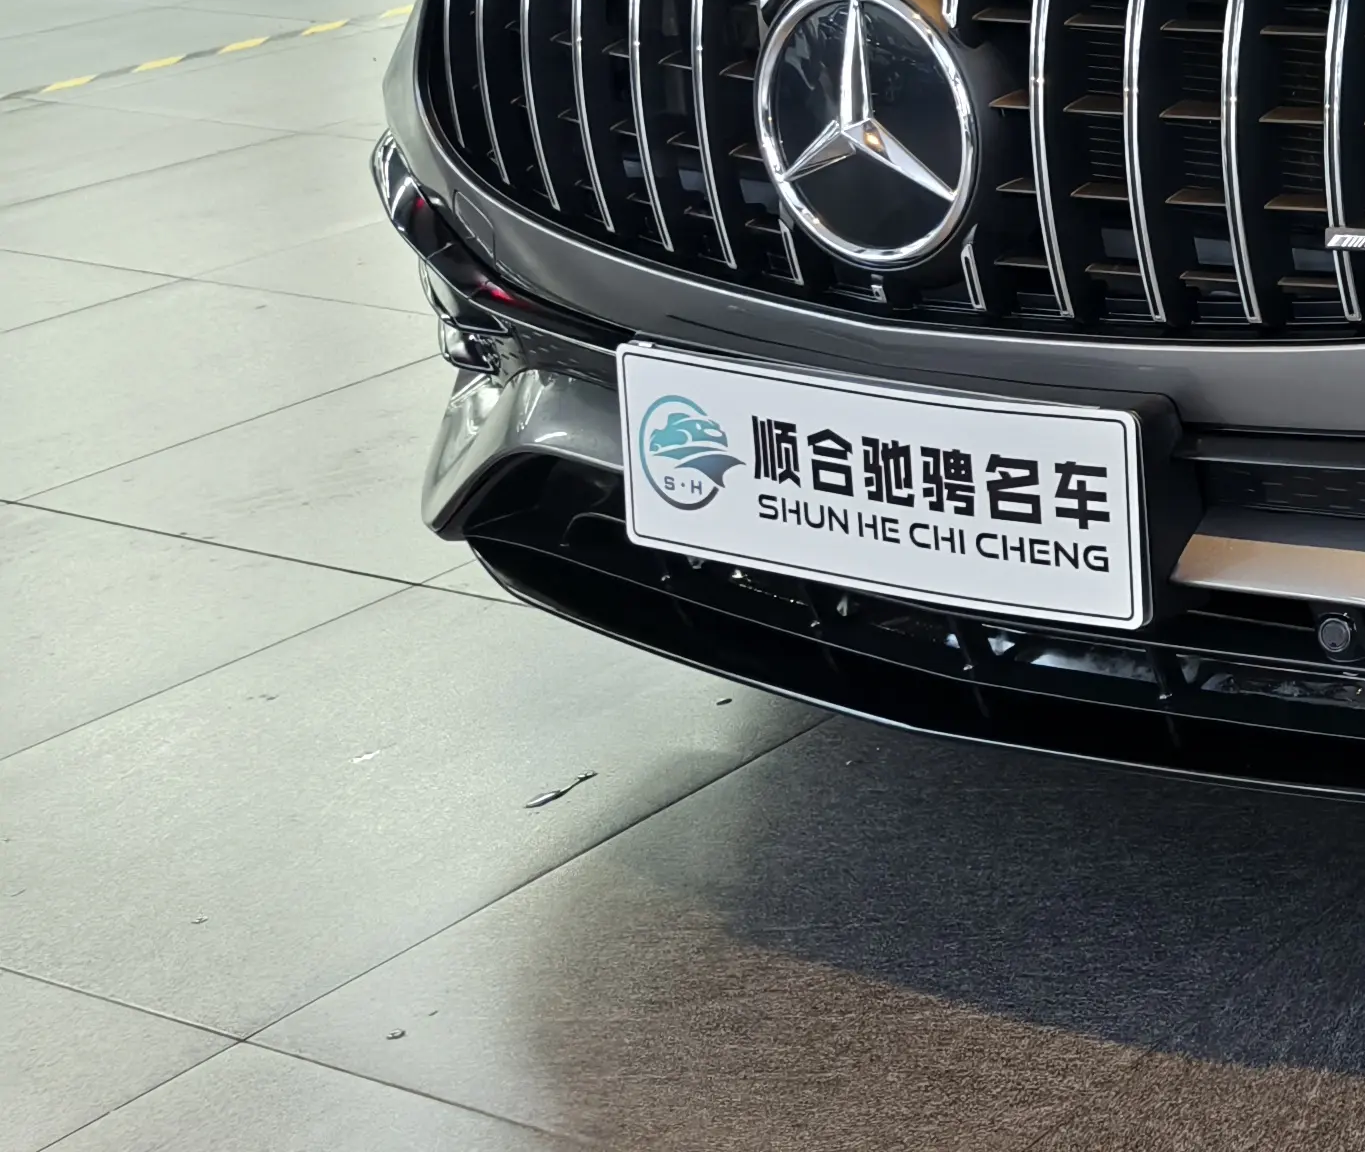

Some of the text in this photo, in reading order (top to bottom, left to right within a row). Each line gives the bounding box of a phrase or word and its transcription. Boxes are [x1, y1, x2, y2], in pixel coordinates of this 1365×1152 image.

[751, 415, 1111, 530] 顺合驰骋名车
[758, 493, 1111, 574] SHUN HE CHI CHENG
